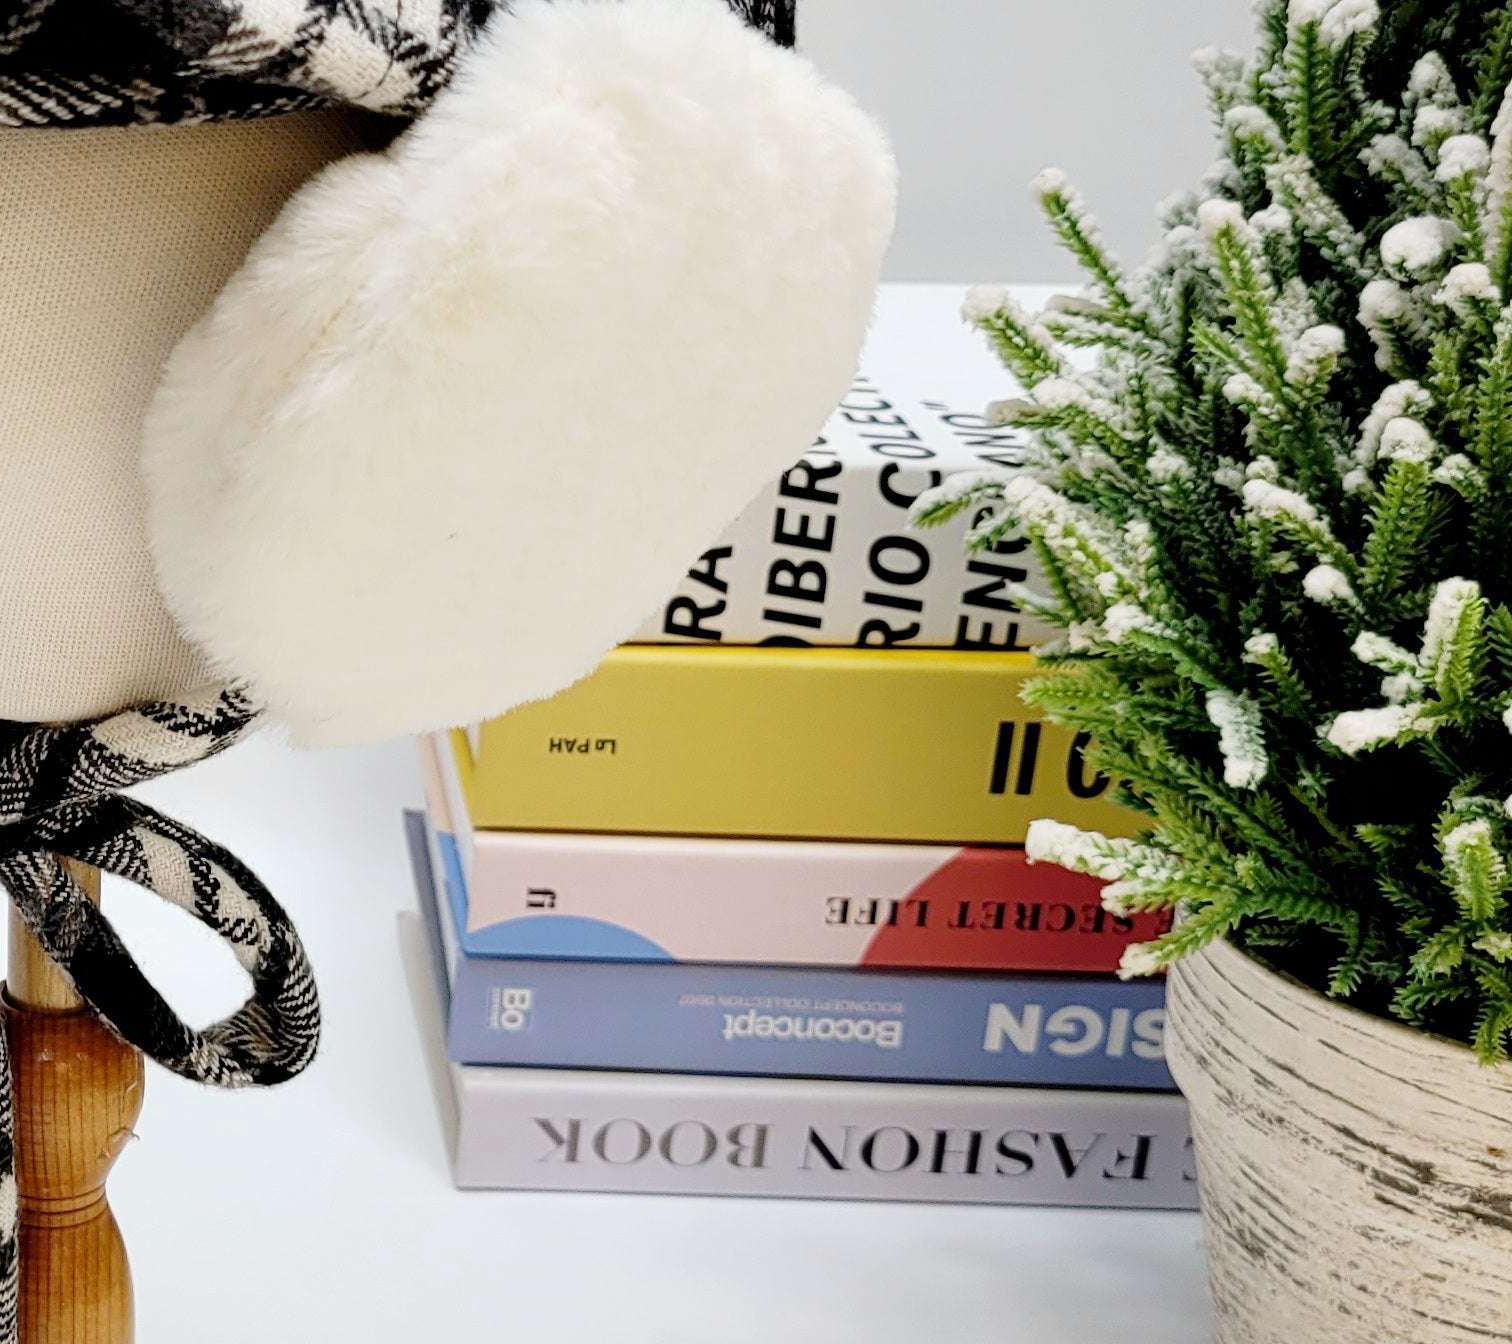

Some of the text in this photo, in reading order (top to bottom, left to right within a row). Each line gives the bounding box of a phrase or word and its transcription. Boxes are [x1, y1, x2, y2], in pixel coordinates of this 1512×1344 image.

[549, 737, 589, 754] PAH
[824, 895, 931, 928] LIFE
[947, 899, 1135, 935] SECRET
[722, 1009, 904, 1048] Boconcept
[532, 1116, 776, 1168] BOOK
[798, 1125, 1159, 1180] FASHON
